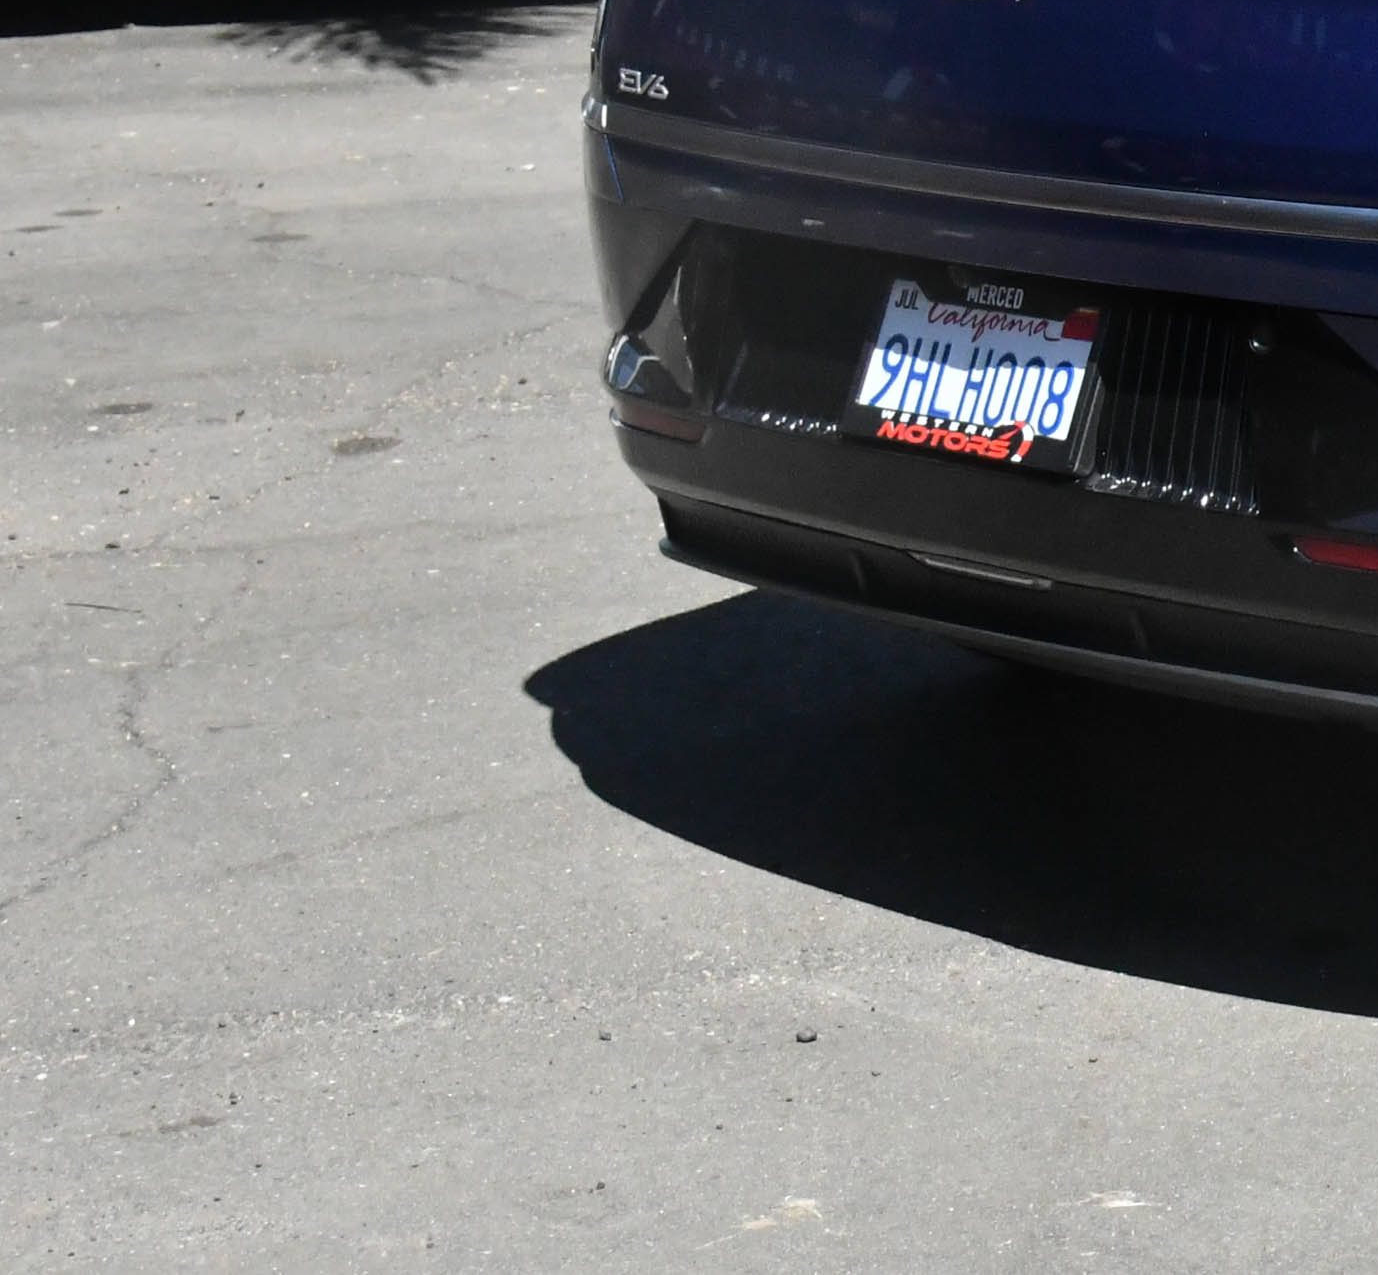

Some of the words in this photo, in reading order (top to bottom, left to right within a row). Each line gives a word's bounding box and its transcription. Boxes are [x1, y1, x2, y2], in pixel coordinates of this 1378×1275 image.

[617, 67, 671, 101] EV6
[894, 288, 919, 311] JUL
[966, 284, 1024, 310] MERCED
[927, 301, 1061, 343] California
[868, 332, 1075, 436] 9HLH008
[876, 419, 1011, 460] MOTORS
[880, 409, 994, 438] WESTERN
